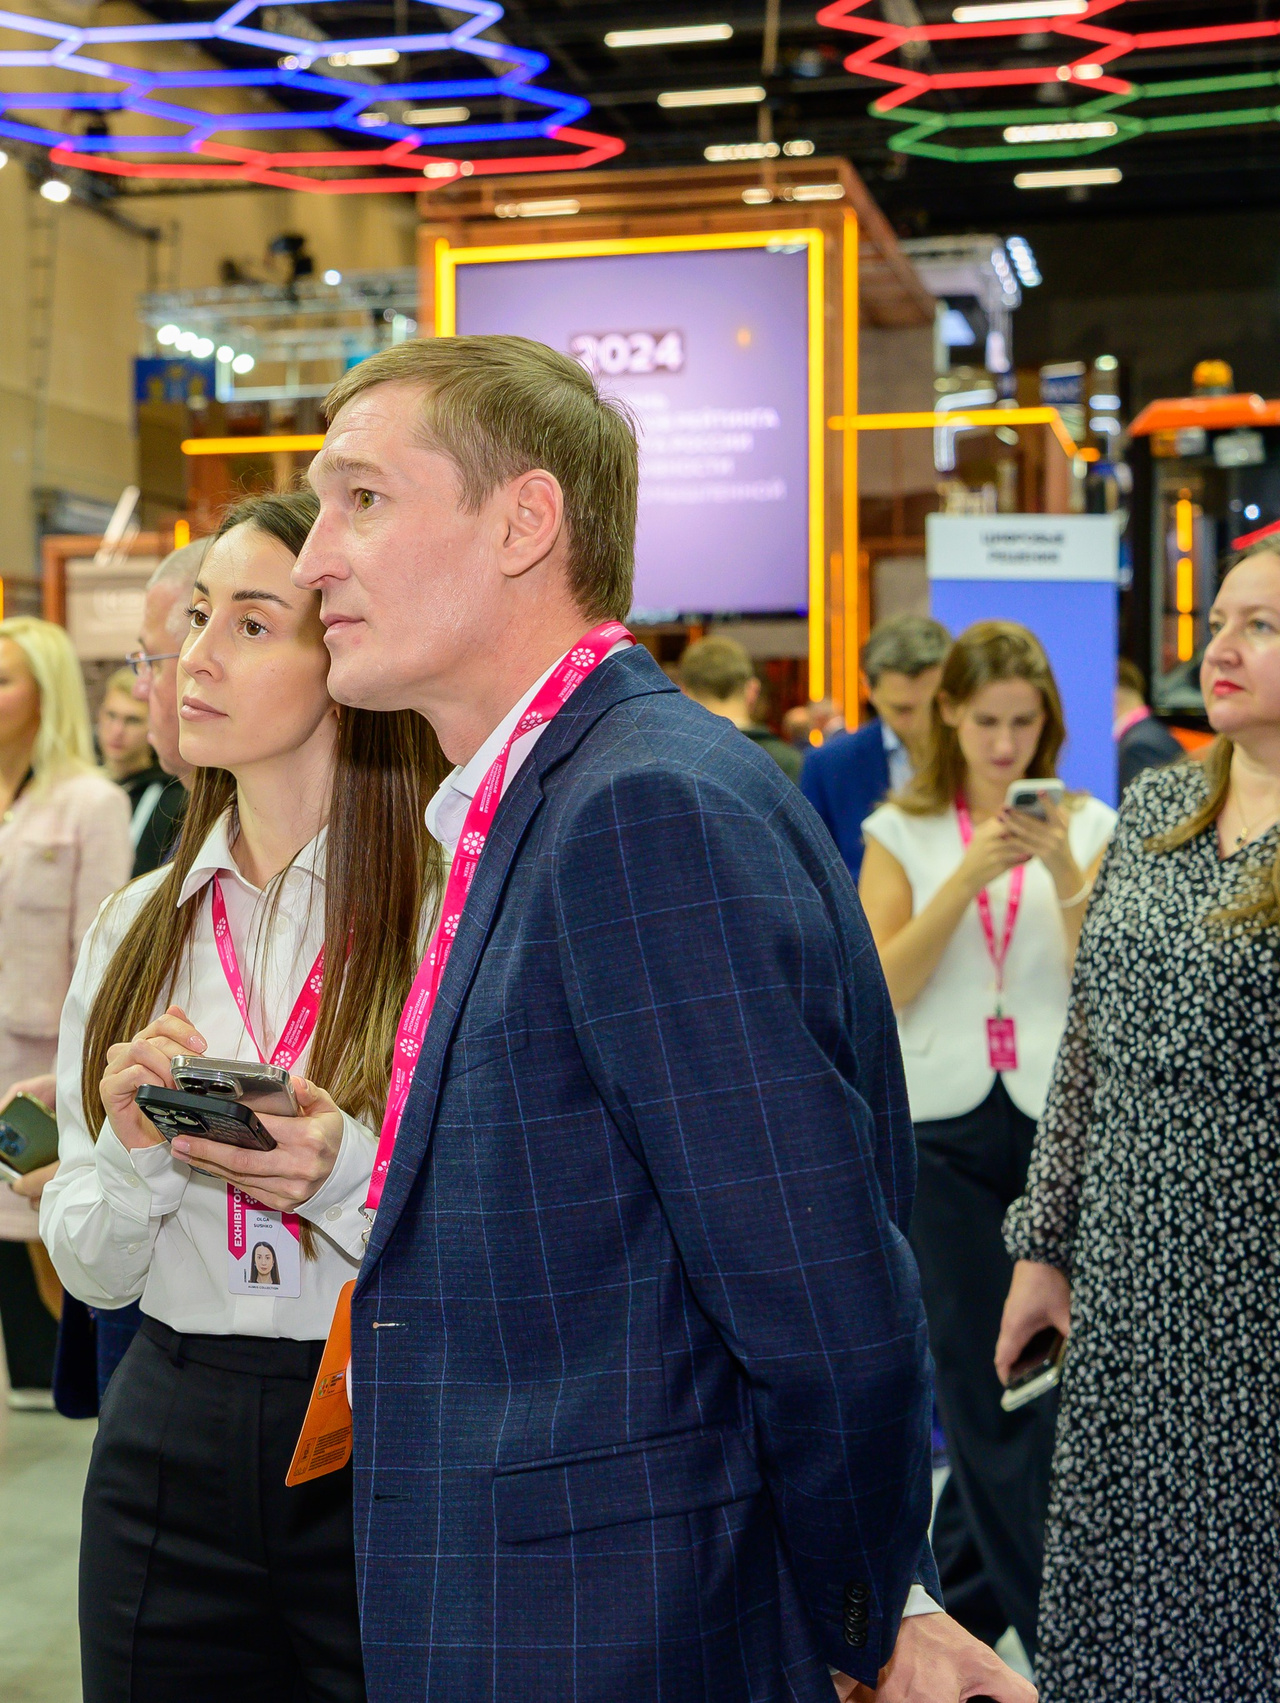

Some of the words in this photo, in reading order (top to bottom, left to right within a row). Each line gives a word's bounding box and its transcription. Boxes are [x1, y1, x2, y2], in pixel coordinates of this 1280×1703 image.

[571, 331, 683, 375] 2024
[558, 671, 579, 698] INDUSTRIAL
[562, 669, 574, 683] WEEK
[463, 861, 471, 877] WEEK
[464, 862, 476, 893] INDUSTRIAL
[403, 1005, 413, 1031] БОЛЬШАЯ
[407, 988, 426, 1033] ПРОМЫШЛЕННАЯ
